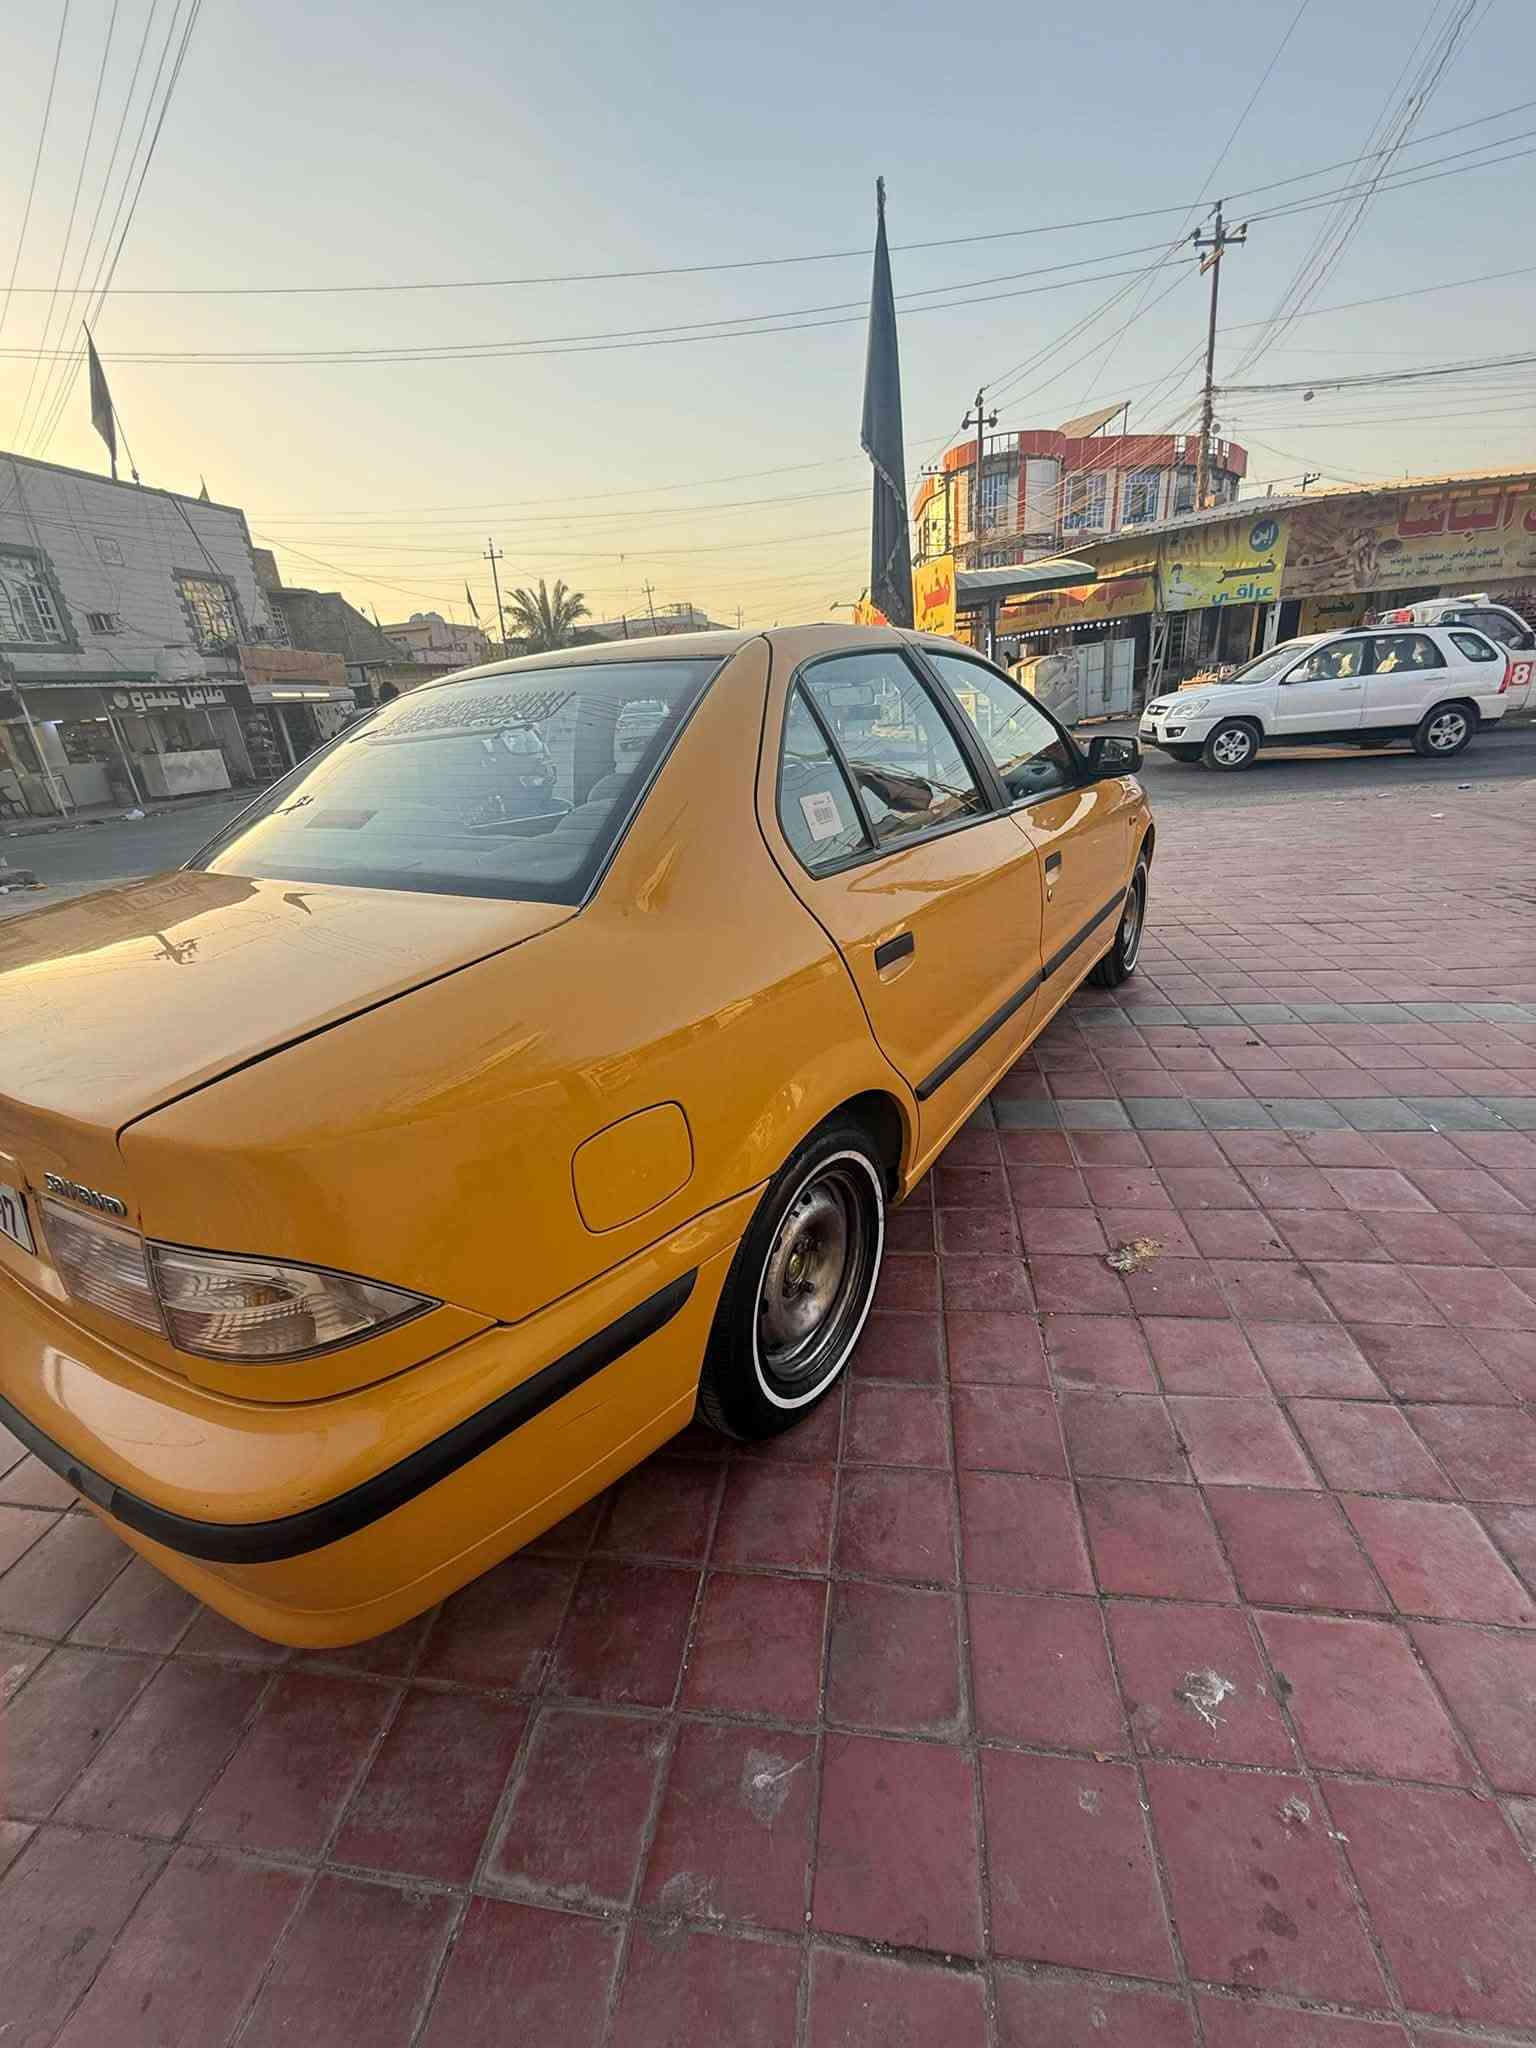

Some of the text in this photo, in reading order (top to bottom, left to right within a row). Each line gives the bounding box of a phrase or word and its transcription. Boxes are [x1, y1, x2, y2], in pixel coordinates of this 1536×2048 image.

[1216, 552, 1276, 584] خبز
[920, 567, 951, 622] مخبز
[1210, 583, 1274, 607] عراقي
[1511, 663, 1531, 685] 8
[182, 686, 227, 710] فلافل
